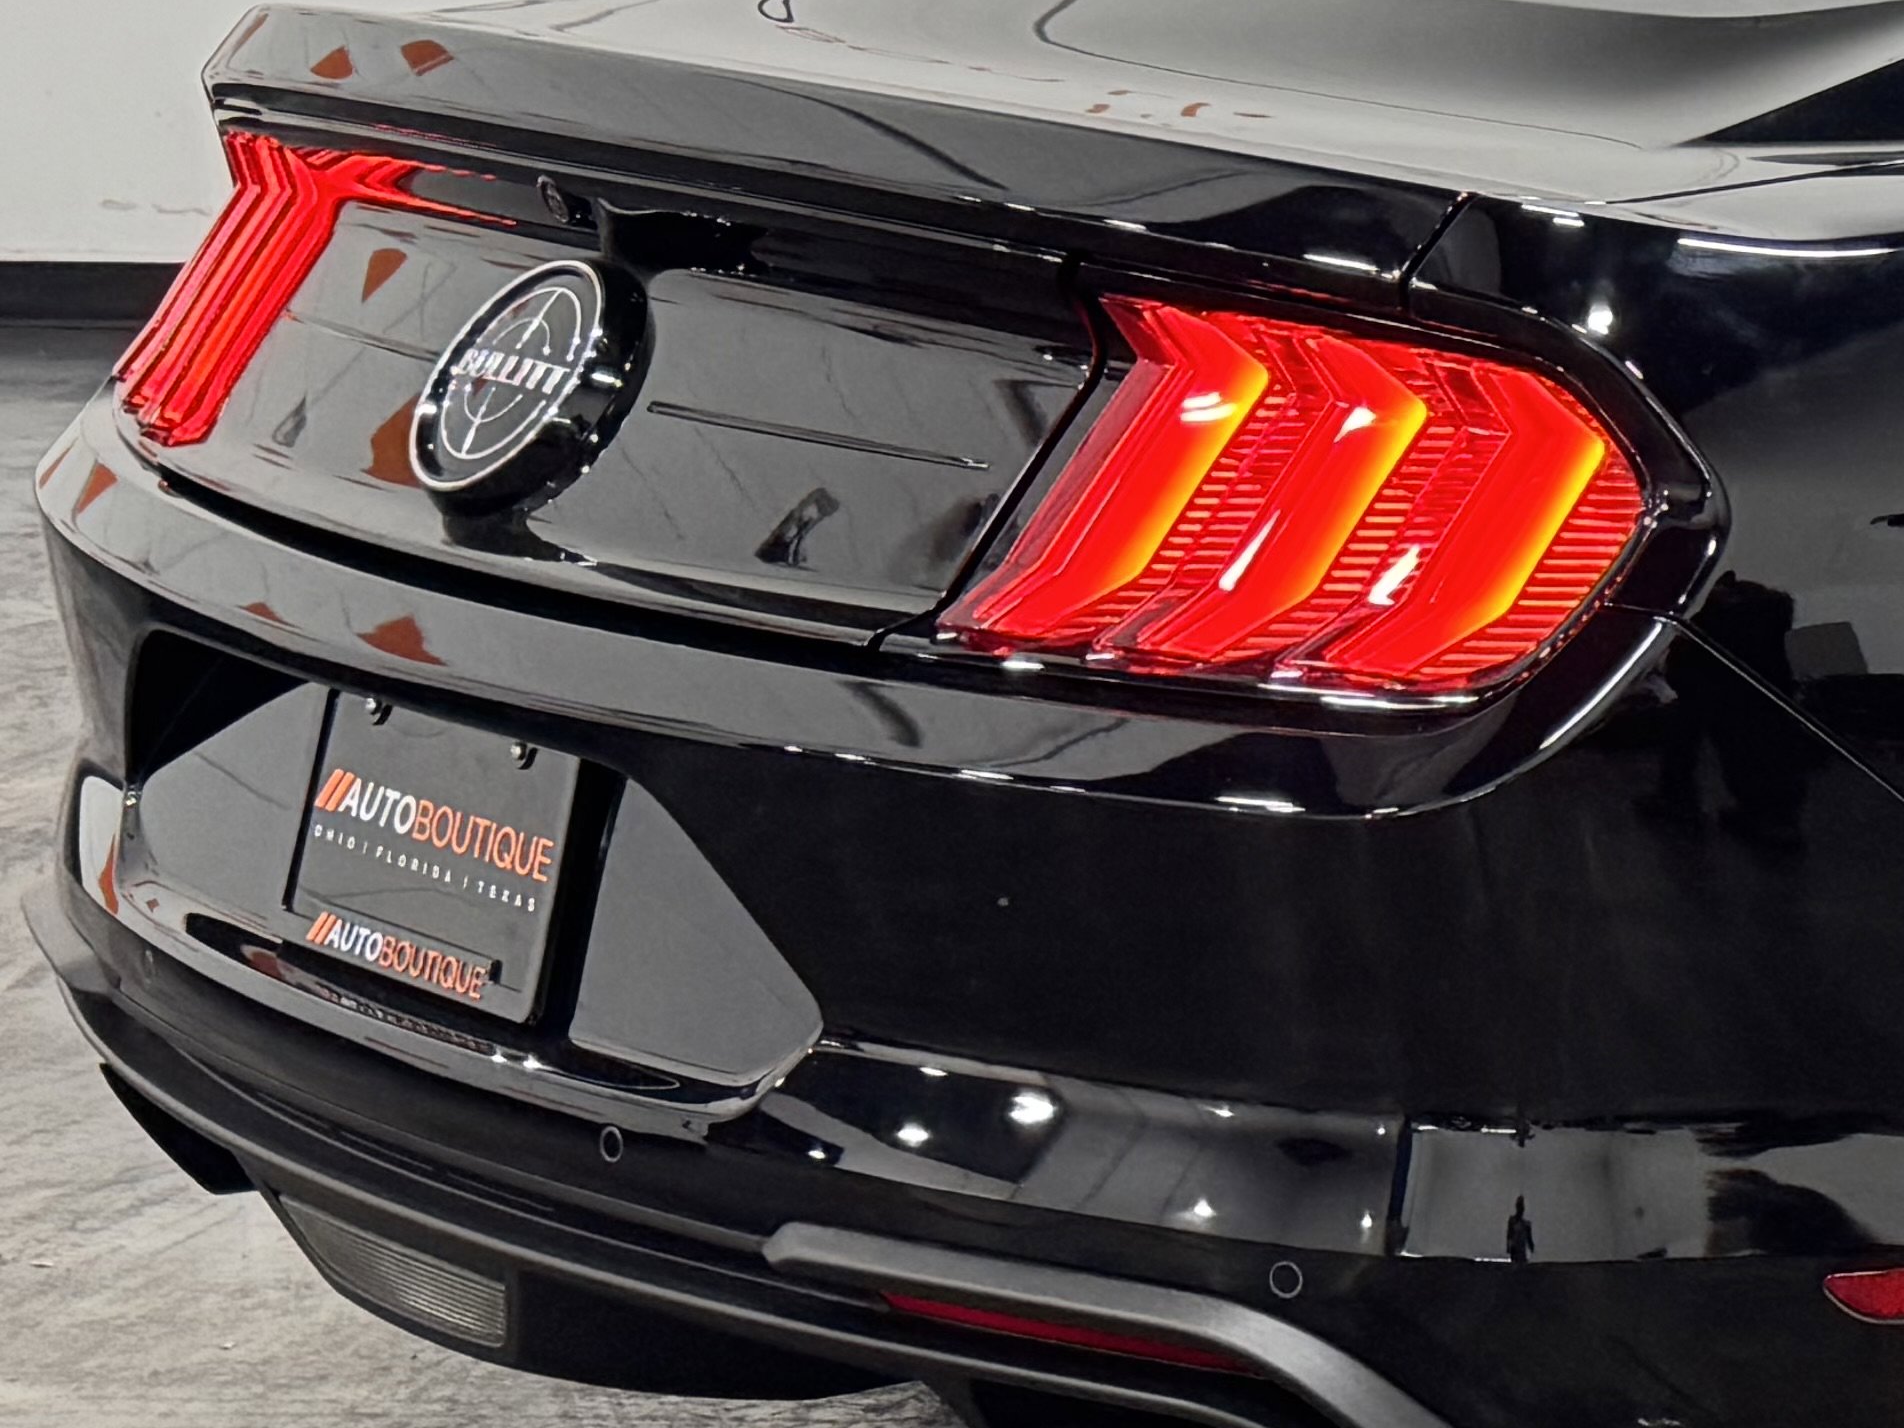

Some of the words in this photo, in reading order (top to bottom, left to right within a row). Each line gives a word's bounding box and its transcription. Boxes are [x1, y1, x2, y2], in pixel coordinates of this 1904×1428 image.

[314, 823, 357, 850] OHIO
[375, 844, 452, 883] FLORIDA
[477, 879, 536, 913] TEXAS
[337, 776, 555, 883] AUTOBOUTIQUE
[324, 917, 487, 1000] AUTOBOUTIQUE
